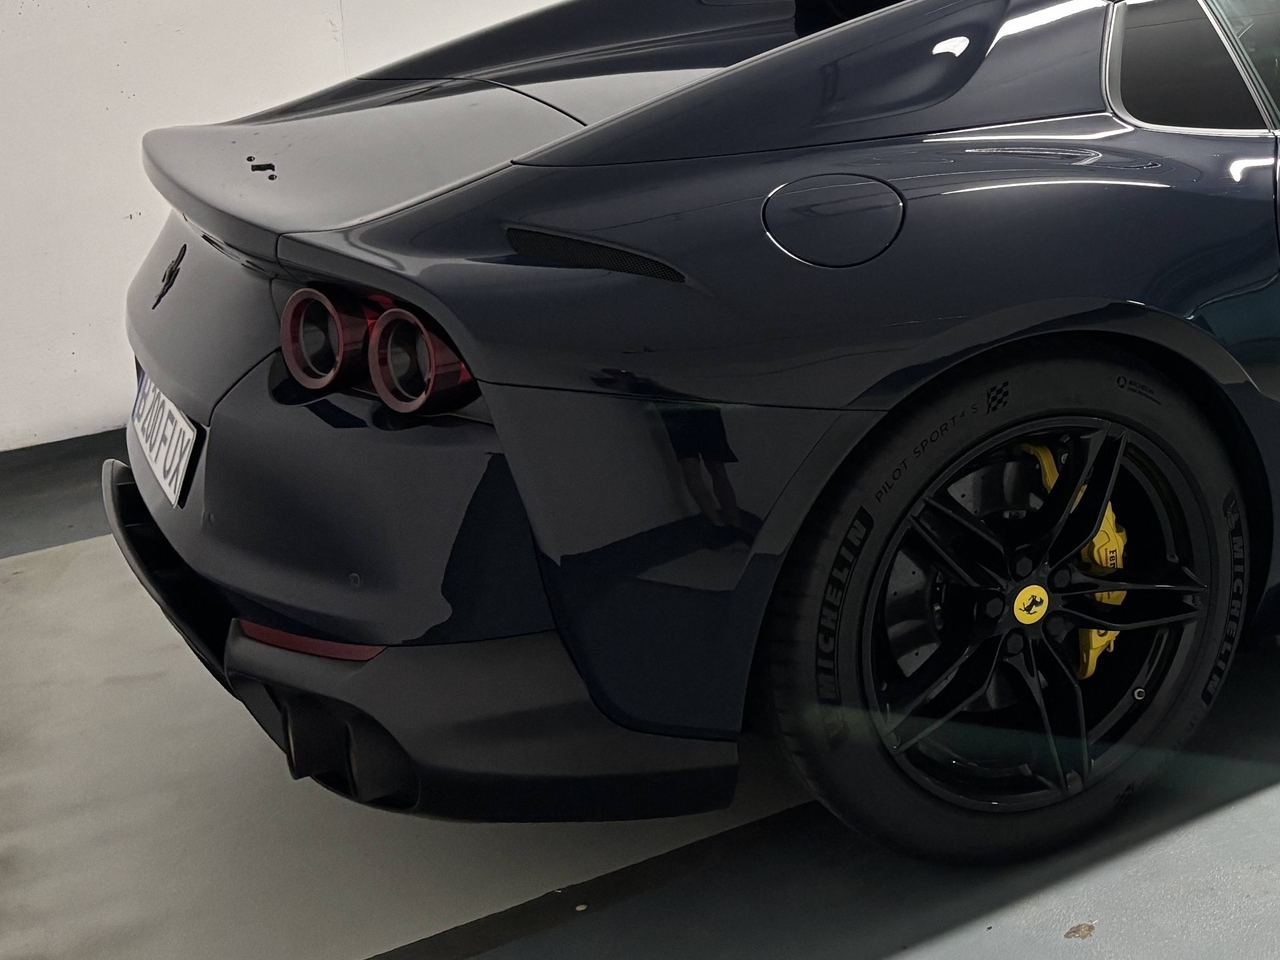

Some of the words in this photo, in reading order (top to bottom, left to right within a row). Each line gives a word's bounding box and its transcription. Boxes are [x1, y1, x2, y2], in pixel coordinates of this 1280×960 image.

[141, 386, 166, 453] 200
[154, 409, 191, 495] FUX
[874, 458, 909, 503] PILOT
[913, 415, 958, 458] SPORT
[959, 409, 966, 418] 4
[971, 403, 979, 414] S
[817, 518, 867, 700] MICHELIN
[1206, 535, 1245, 696] MICHELIN
